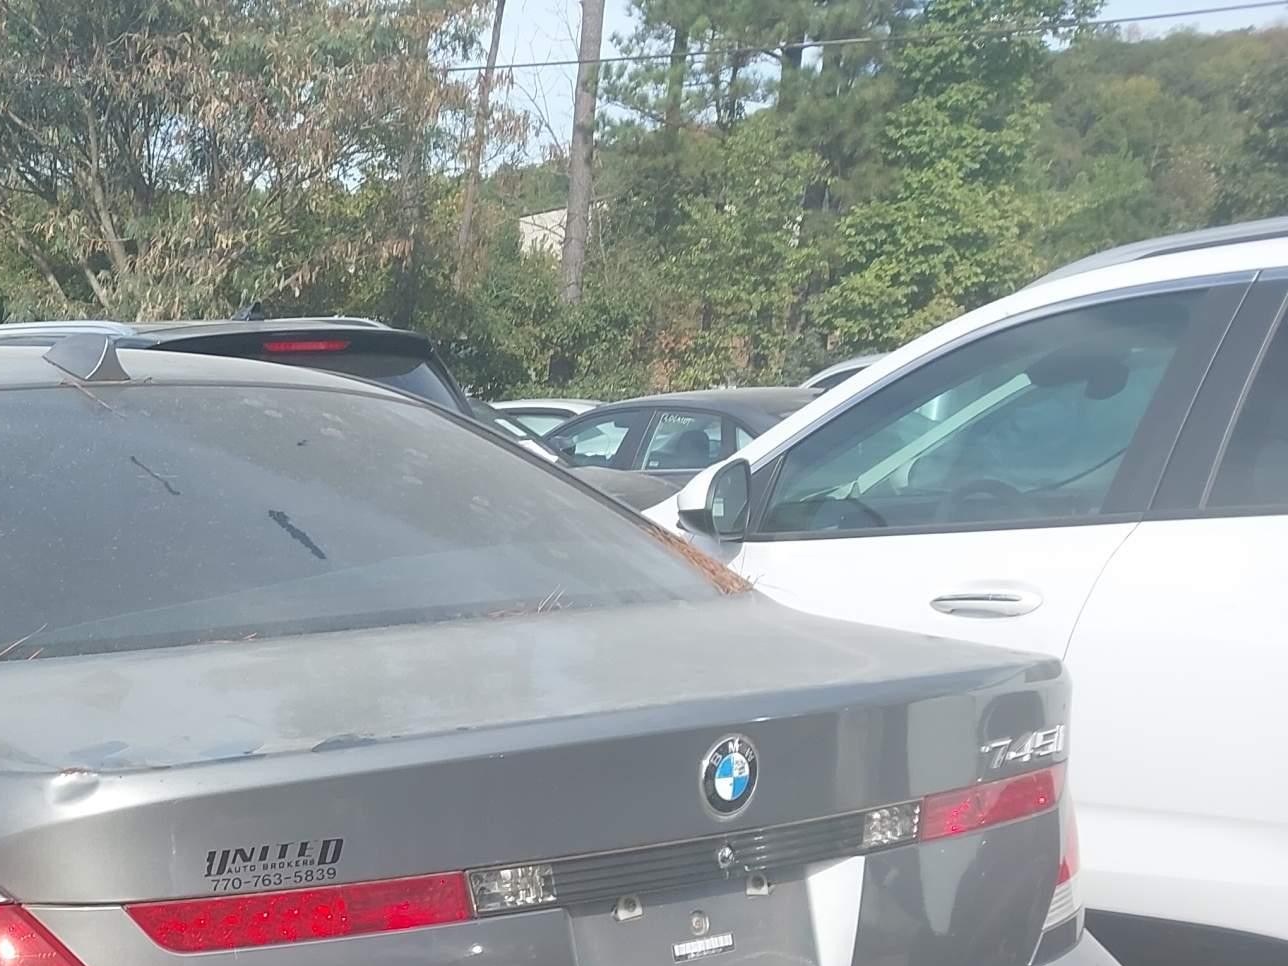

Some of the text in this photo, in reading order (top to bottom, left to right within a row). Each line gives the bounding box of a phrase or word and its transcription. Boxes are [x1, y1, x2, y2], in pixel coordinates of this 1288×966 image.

[710, 737, 755, 767] BMW
[205, 838, 344, 877] UNITED
[226, 858, 315, 875] AUTO BROKERS
[211, 867, 337, 892] 770-763-5839
